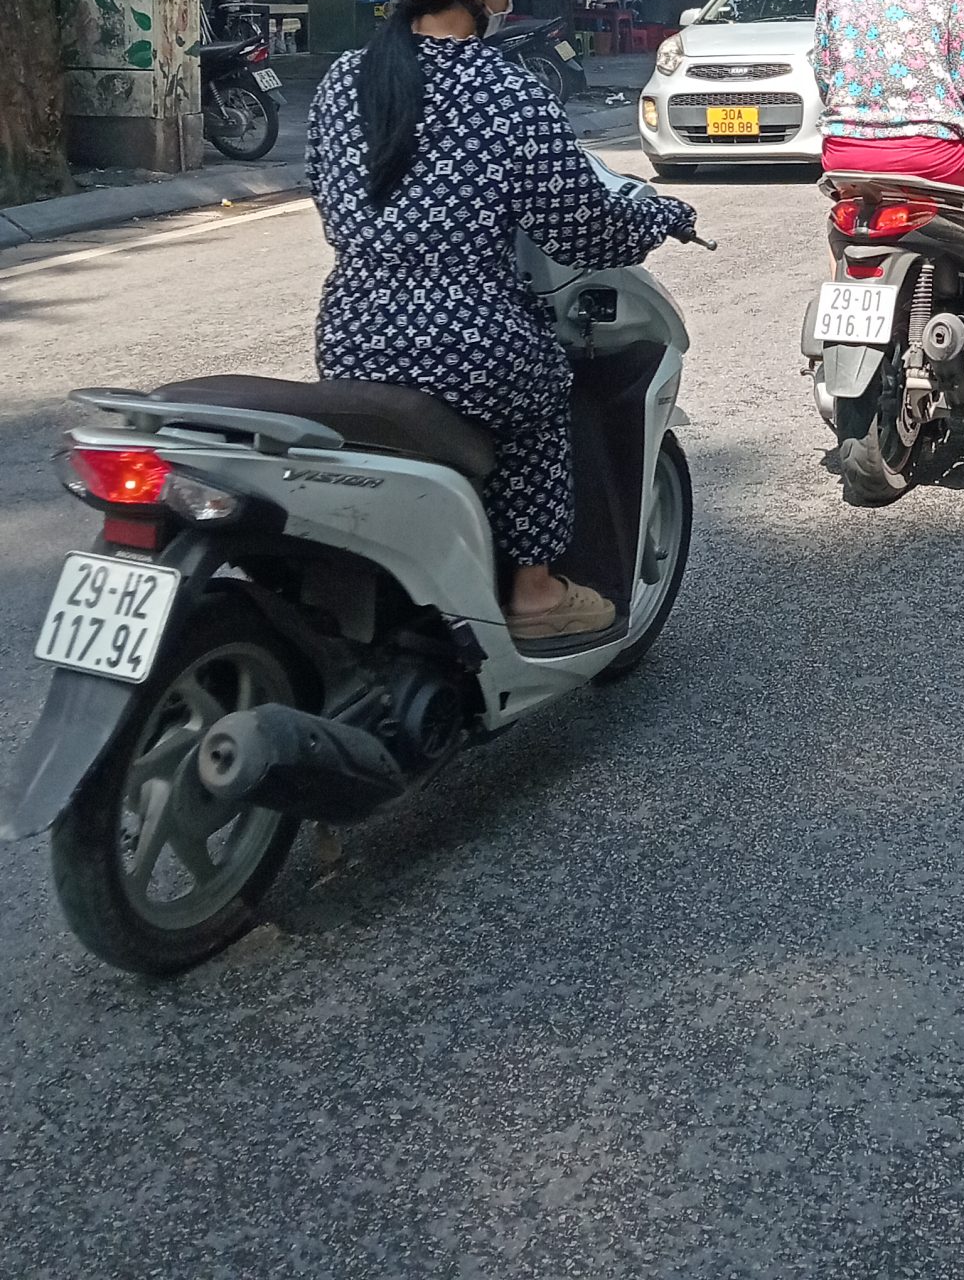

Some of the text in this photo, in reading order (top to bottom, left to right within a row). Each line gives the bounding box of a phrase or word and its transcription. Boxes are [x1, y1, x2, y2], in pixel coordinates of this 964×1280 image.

[721, 109, 743, 120] 30A
[712, 121, 753, 133] 908.88
[831, 288, 882, 312] 29-D1
[820, 313, 886, 338] 916.17
[66, 563, 158, 620] 29-H2
[47, 610, 149, 673] 117.94
